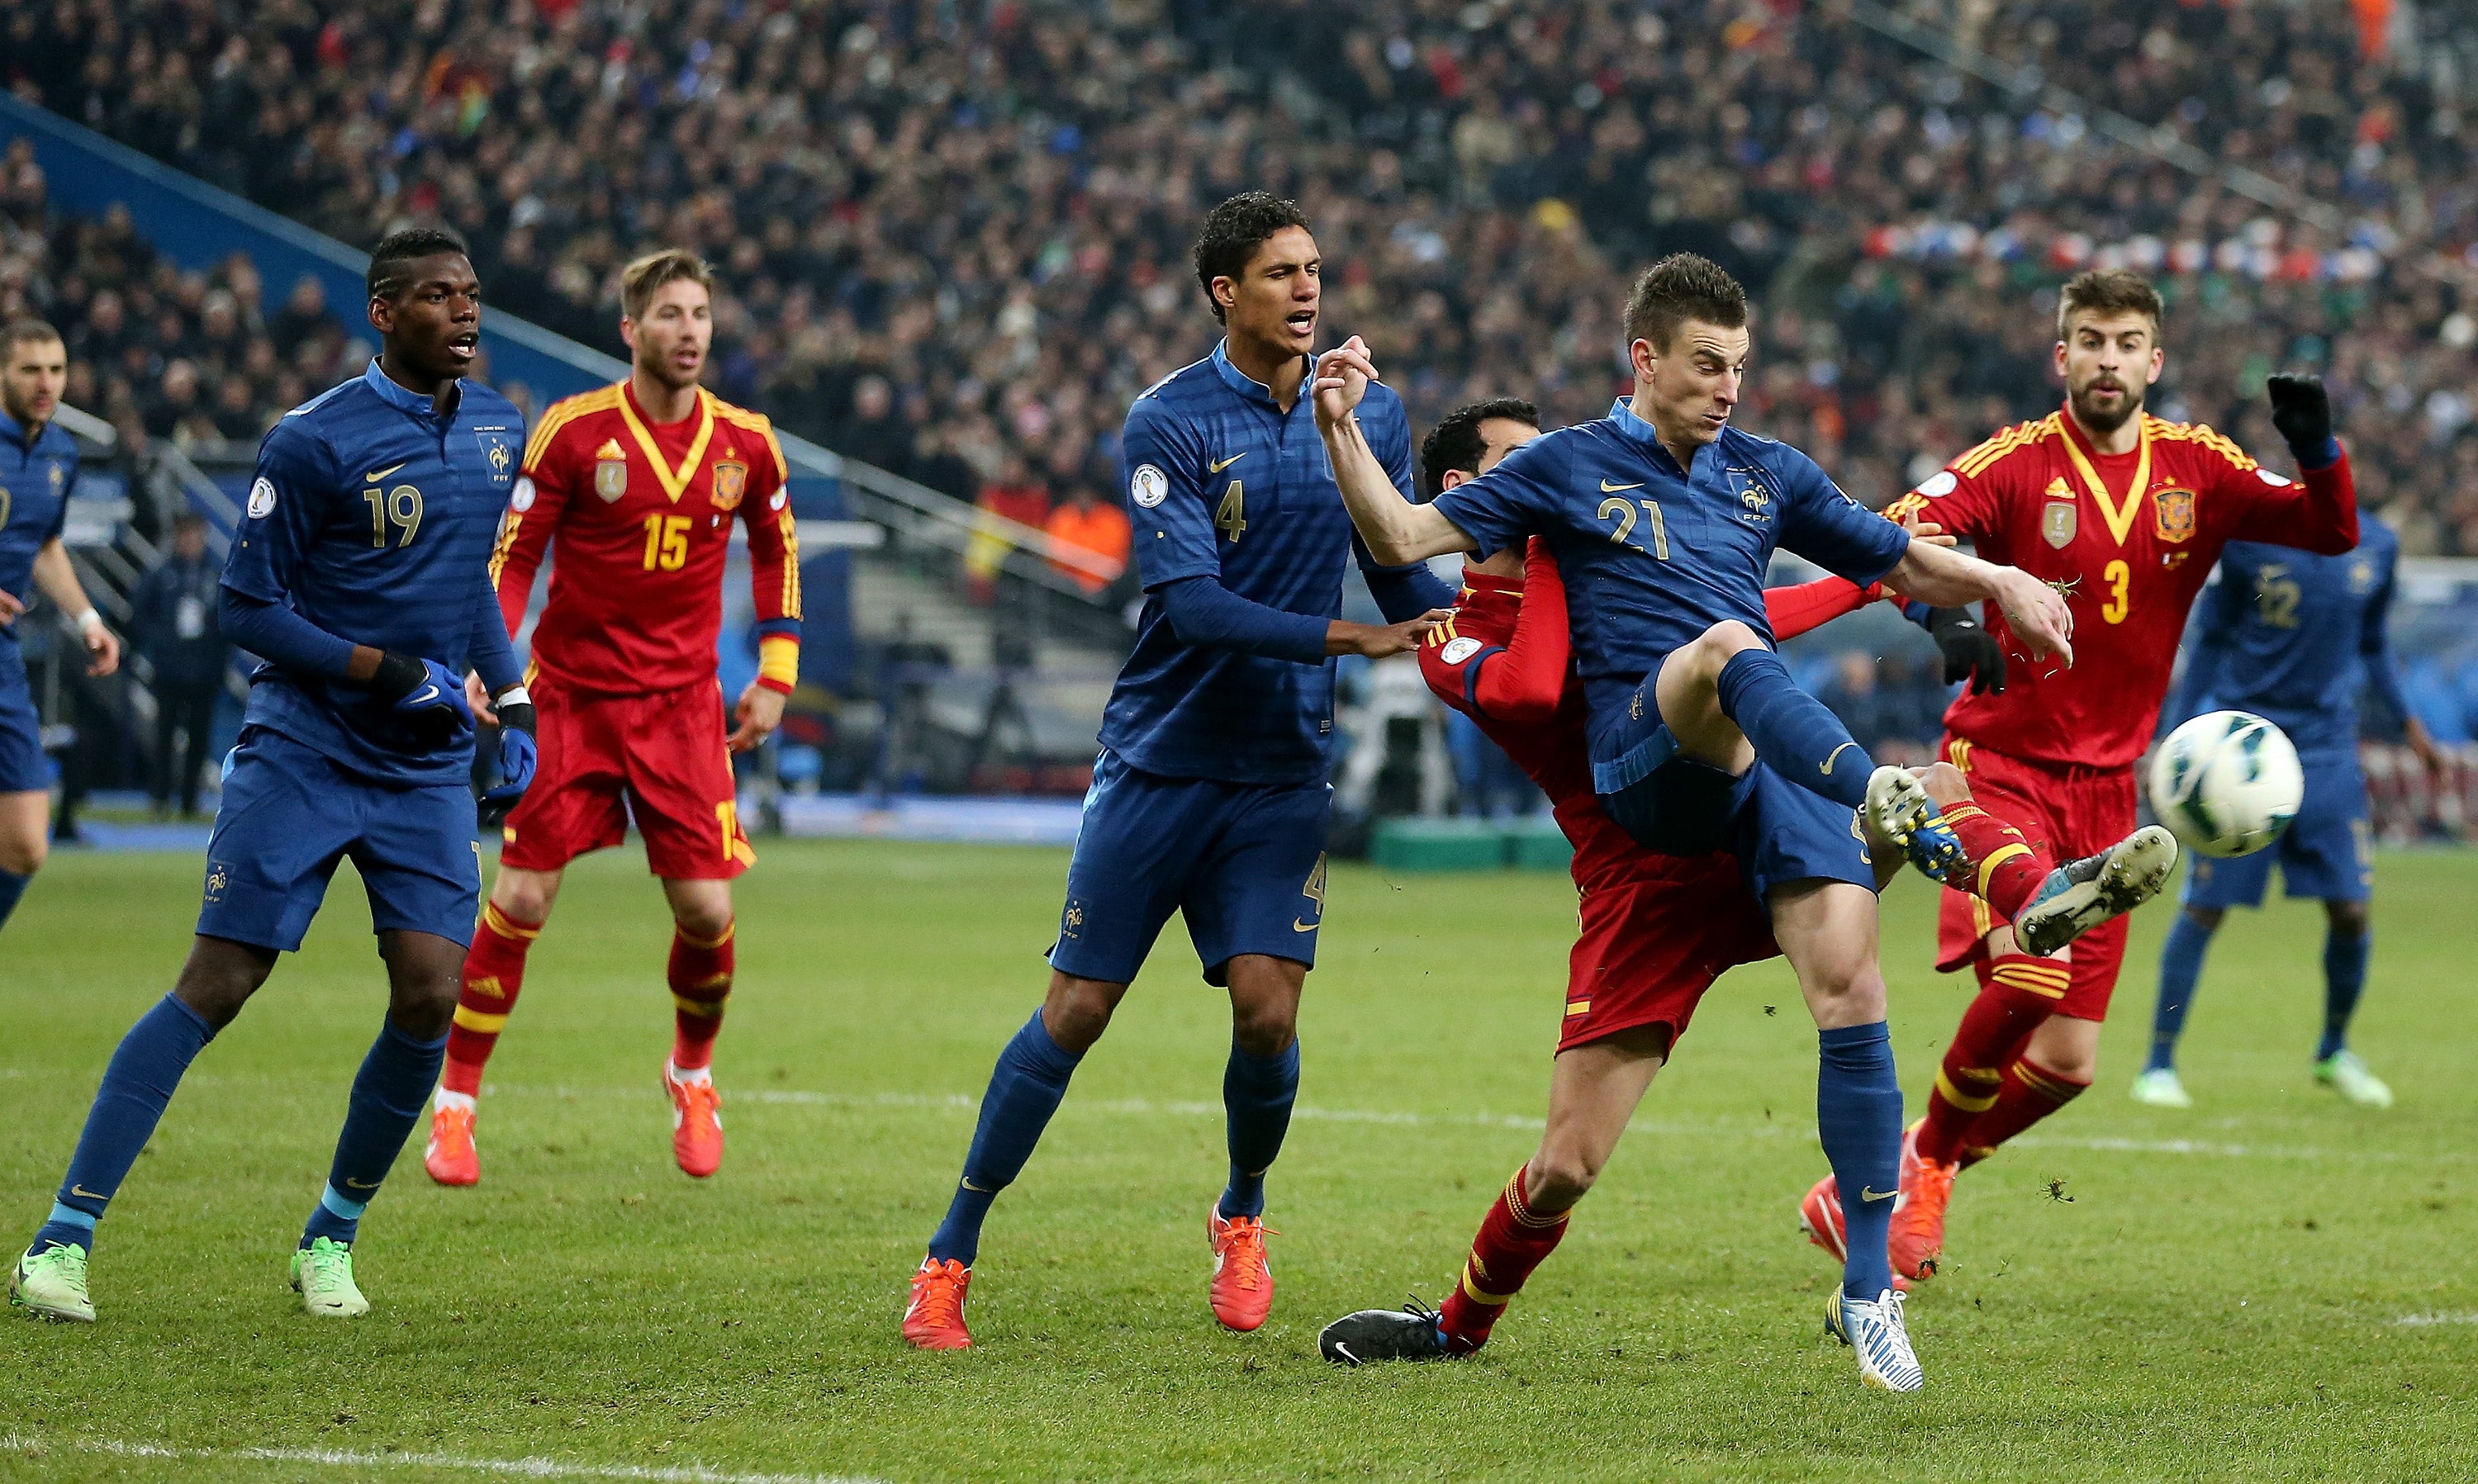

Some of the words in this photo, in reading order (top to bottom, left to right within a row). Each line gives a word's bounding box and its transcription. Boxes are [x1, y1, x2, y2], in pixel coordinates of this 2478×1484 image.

[363, 484, 424, 548] 19
[643, 512, 694, 572] 15
[1214, 480, 1246, 543] 4
[1597, 497, 1669, 560] 21
[1743, 514, 1771, 523] FFF
[2101, 558, 2130, 625] 3
[1303, 850, 1326, 916] 4
